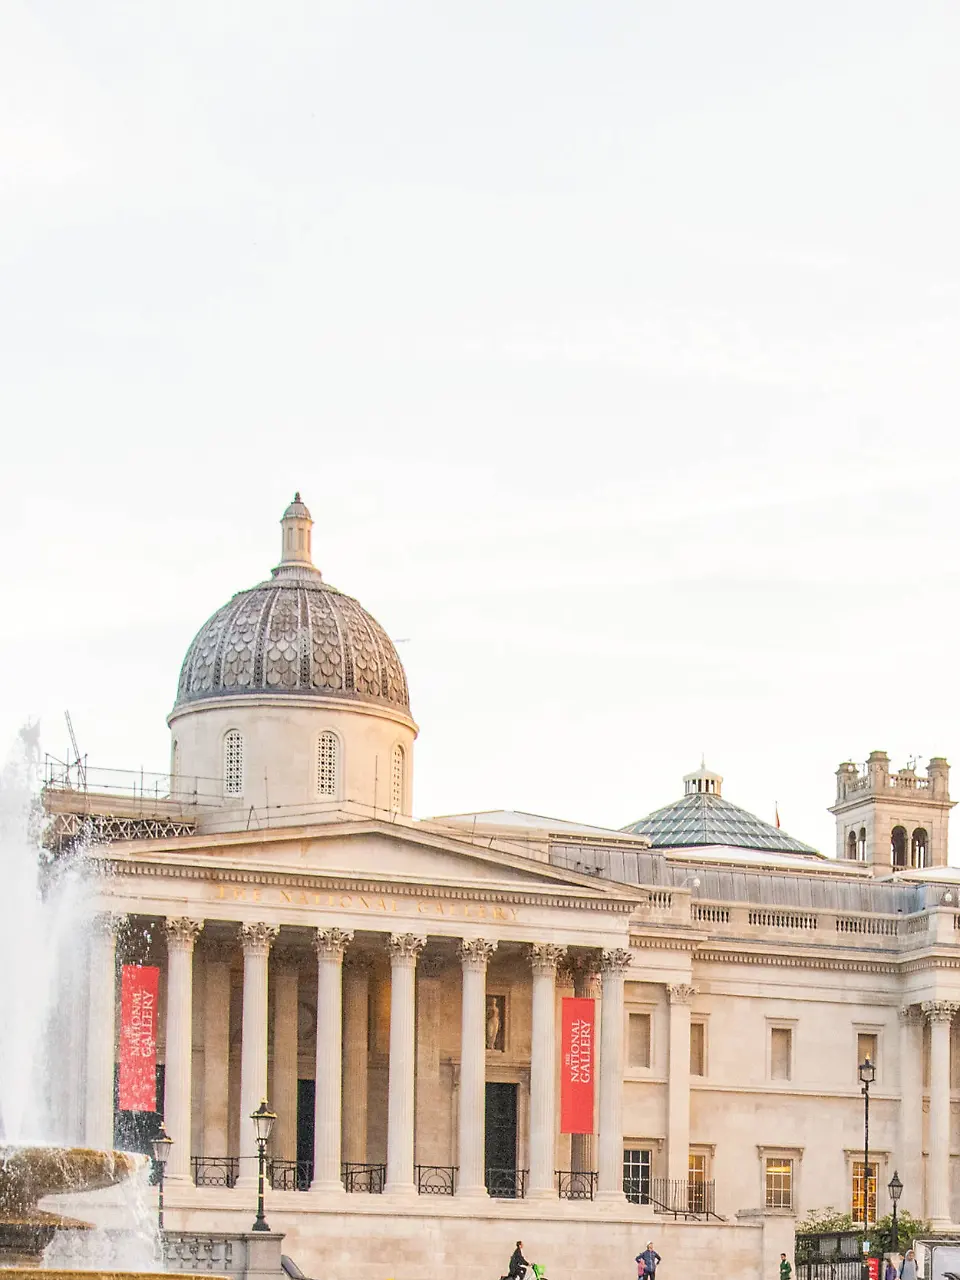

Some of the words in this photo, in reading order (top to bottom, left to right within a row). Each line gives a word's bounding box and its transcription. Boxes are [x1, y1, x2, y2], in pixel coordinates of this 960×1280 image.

[215, 884, 263, 901] THE
[280, 890, 397, 912] NATIONAL
[416, 900, 519, 920] GALLERY
[131, 990, 142, 1057] NATIONAL
[142, 991, 154, 1058] GALLERY
[571, 1019, 580, 1083] NATIONAL
[580, 1020, 591, 1083] GALLERY
